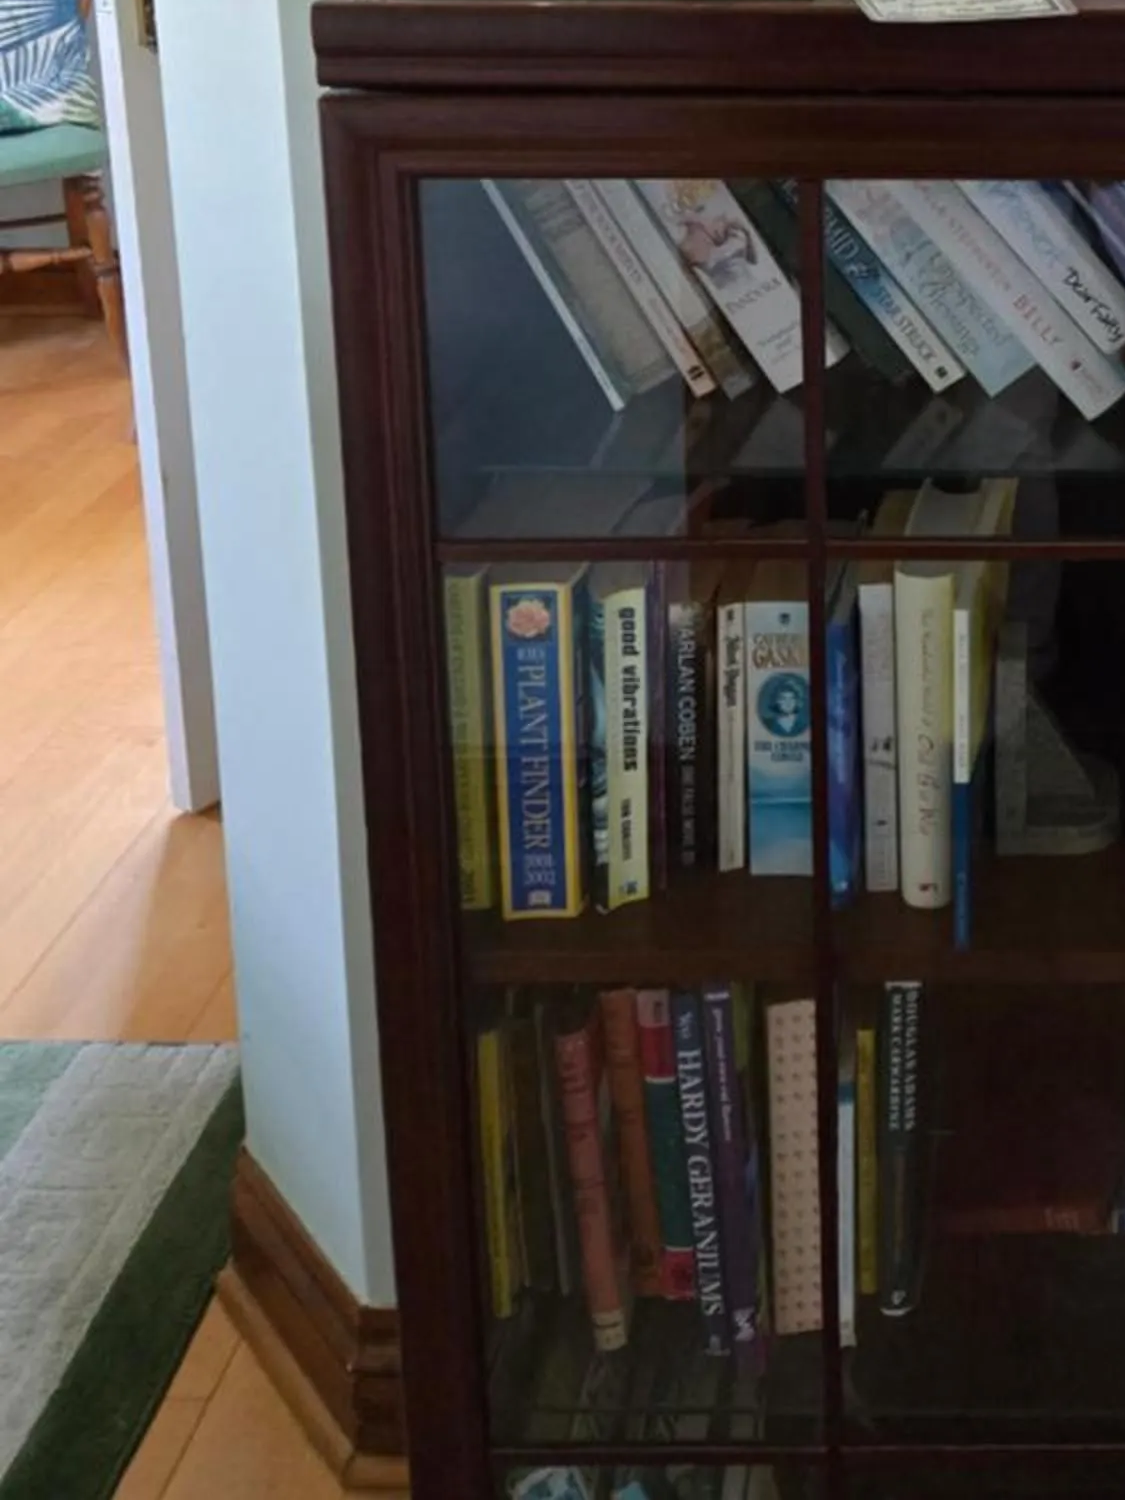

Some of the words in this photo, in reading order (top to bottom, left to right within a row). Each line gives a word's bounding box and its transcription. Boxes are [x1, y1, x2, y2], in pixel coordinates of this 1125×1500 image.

[1011, 292, 1065, 350] BILLY
[618, 606, 640, 656] good
[517, 664, 549, 751] PLANT
[620, 664, 641, 772] vibrations
[677, 696, 697, 761] COBEN
[520, 754, 551, 851] FINDER
[676, 1048, 710, 1147] HARDY
[904, 1072, 918, 1132] ADAMS
[686, 1155, 725, 1317] GERANIUMS
